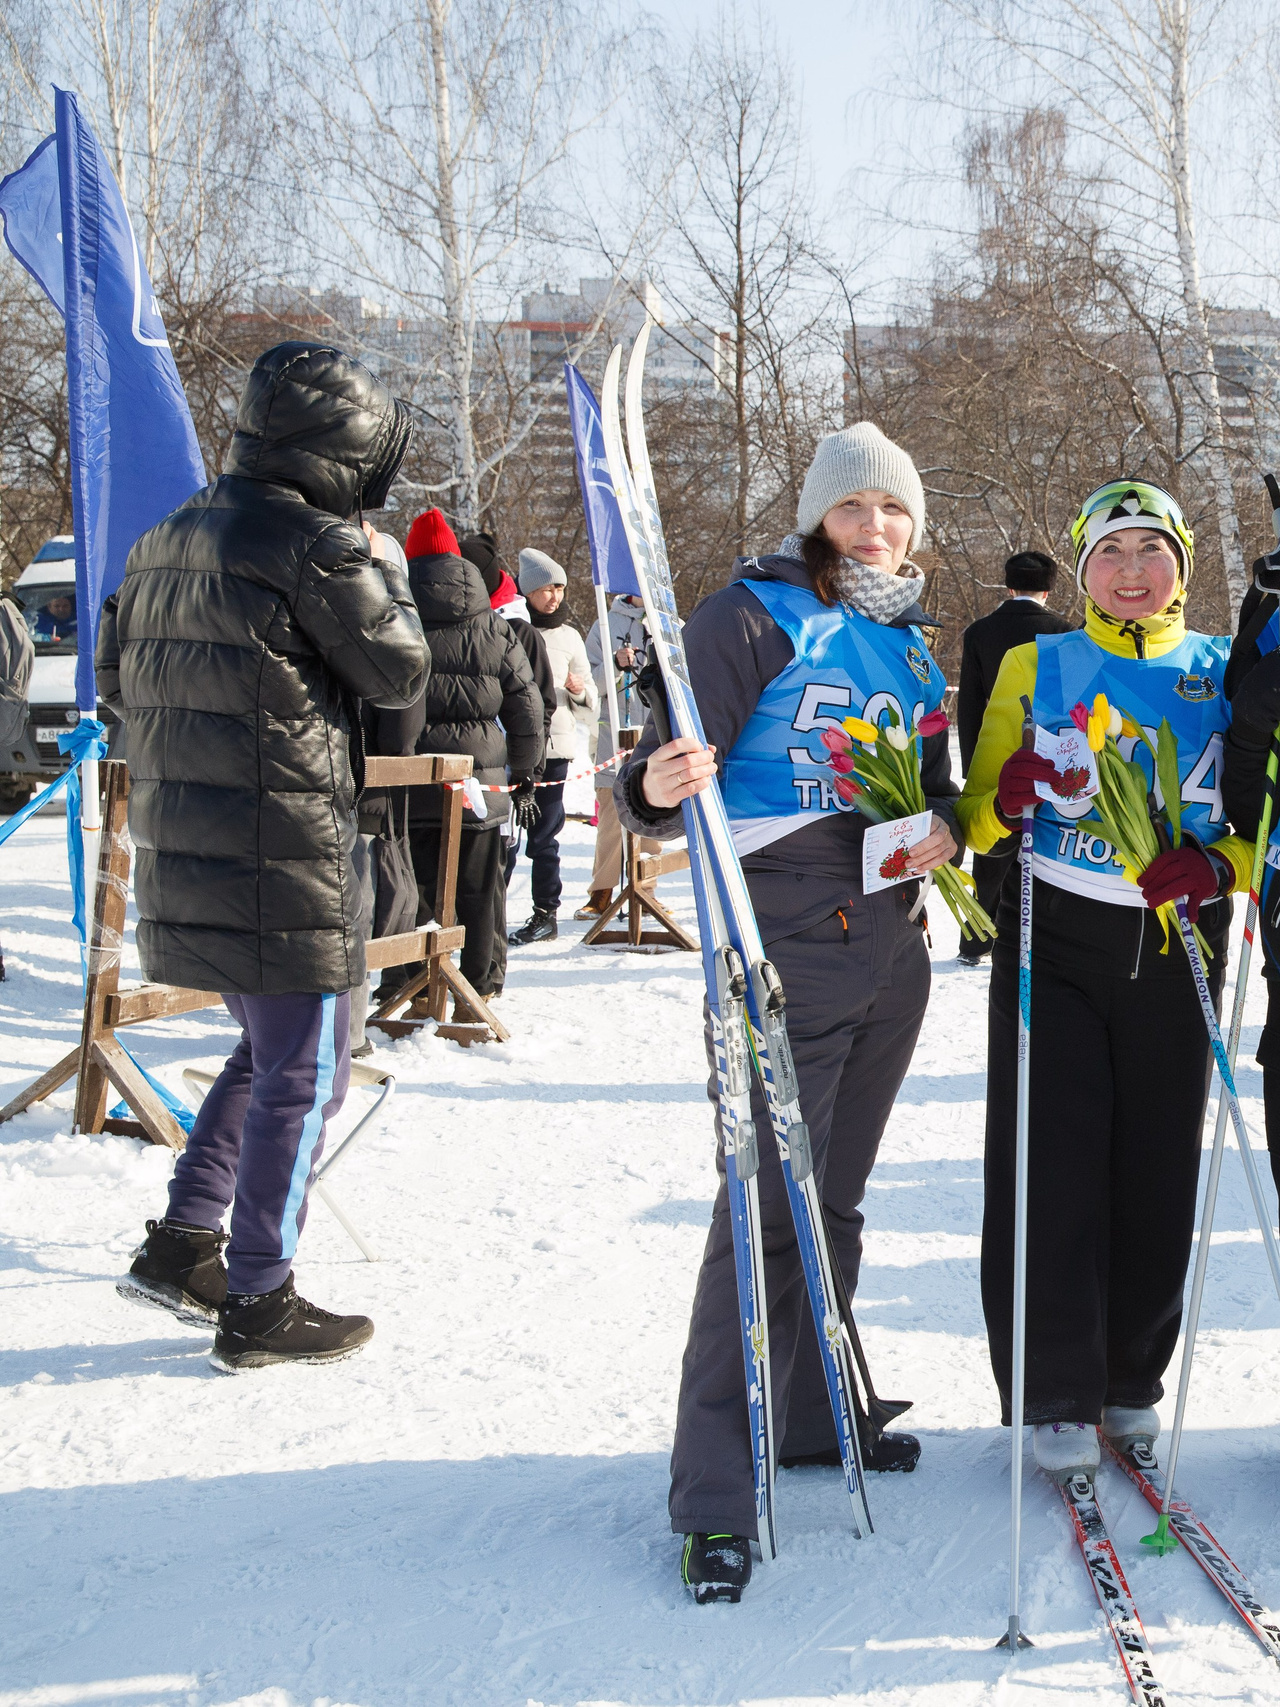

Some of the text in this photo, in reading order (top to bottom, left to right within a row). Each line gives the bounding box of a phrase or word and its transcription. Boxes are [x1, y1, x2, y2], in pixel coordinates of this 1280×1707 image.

[1021, 858, 1032, 928] NORDWAY
[1185, 941, 1210, 1003] NORDWAY
[710, 1010, 737, 1157] ALPHA
[749, 1023, 790, 1161] ALPHA
